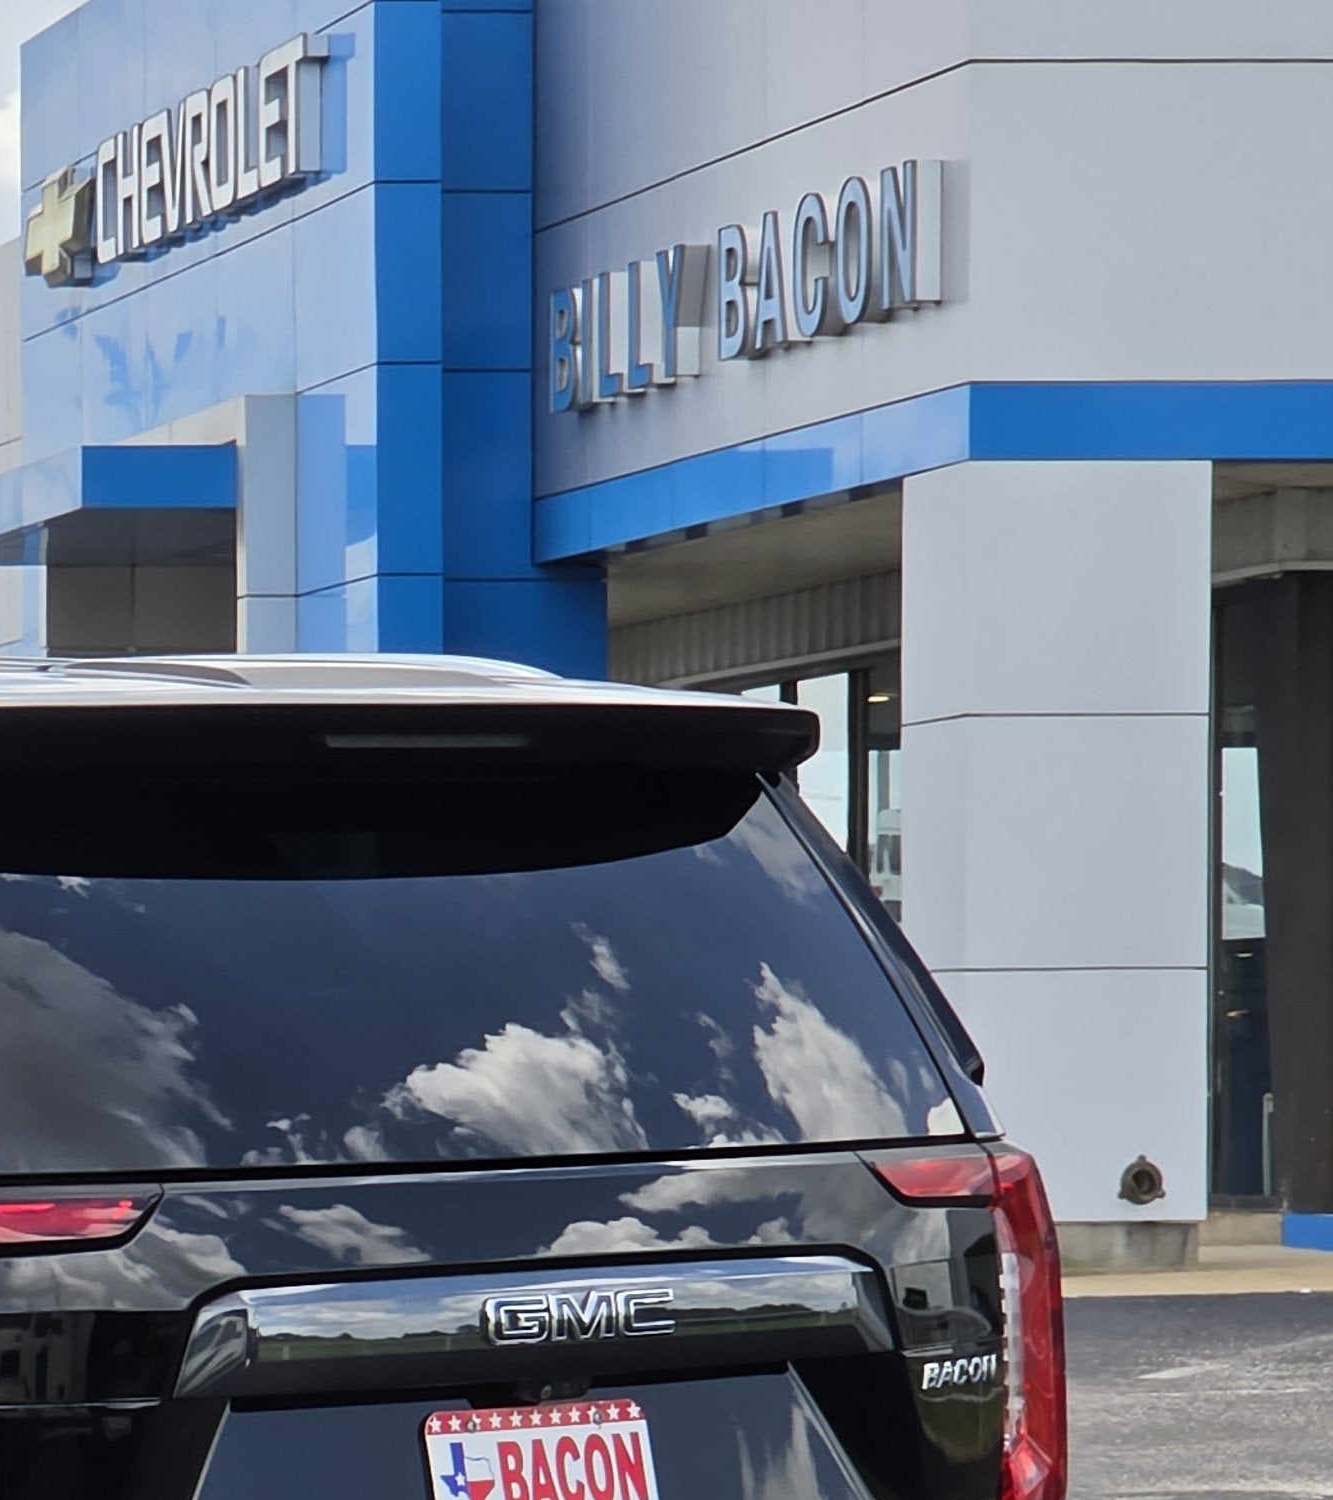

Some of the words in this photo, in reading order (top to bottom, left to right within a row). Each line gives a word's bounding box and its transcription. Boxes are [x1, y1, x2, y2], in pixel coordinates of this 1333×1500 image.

[96, 32, 311, 264] CHEVROLET
[549, 244, 689, 414] BILLY
[718, 160, 921, 361] BACON
[484, 1287, 677, 1346] GMC
[921, 1353, 997, 1391] BACON
